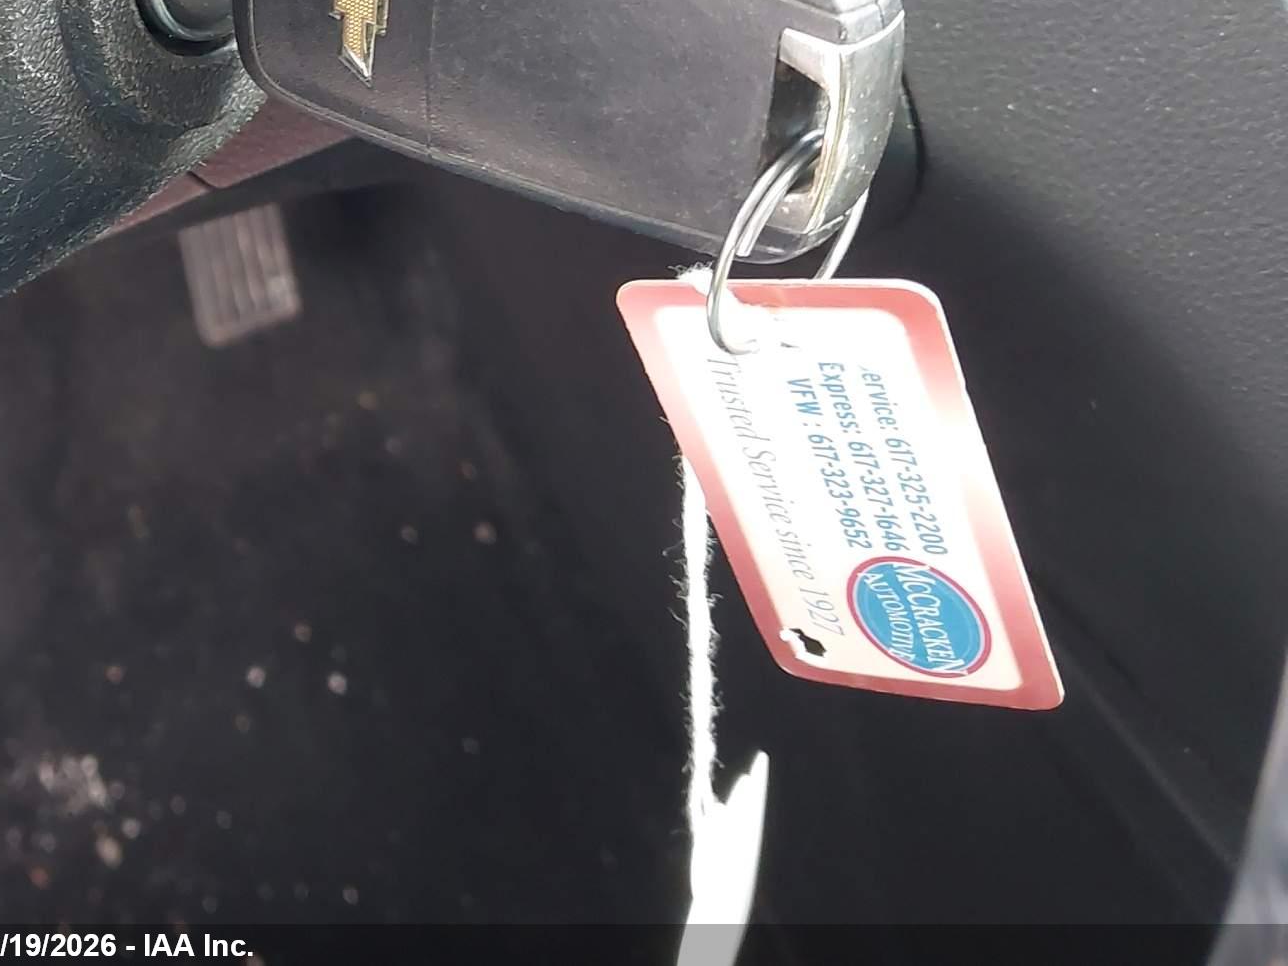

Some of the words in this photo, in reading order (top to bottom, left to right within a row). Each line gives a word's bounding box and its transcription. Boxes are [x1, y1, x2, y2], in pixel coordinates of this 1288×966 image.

[707, 357, 769, 442] Trusted
[746, 446, 792, 525] Service
[774, 527, 815, 582] since
[798, 588, 846, 636] 1927
[807, 433, 872, 549] 617-323-9652
[818, 362, 860, 435] Express:
[849, 441, 904, 552] 617-327-1646
[860, 366, 899, 432] ervice:
[885, 437, 948, 556] 617-325-2200
[857, 571, 915, 661] AUTOMOTIVE
